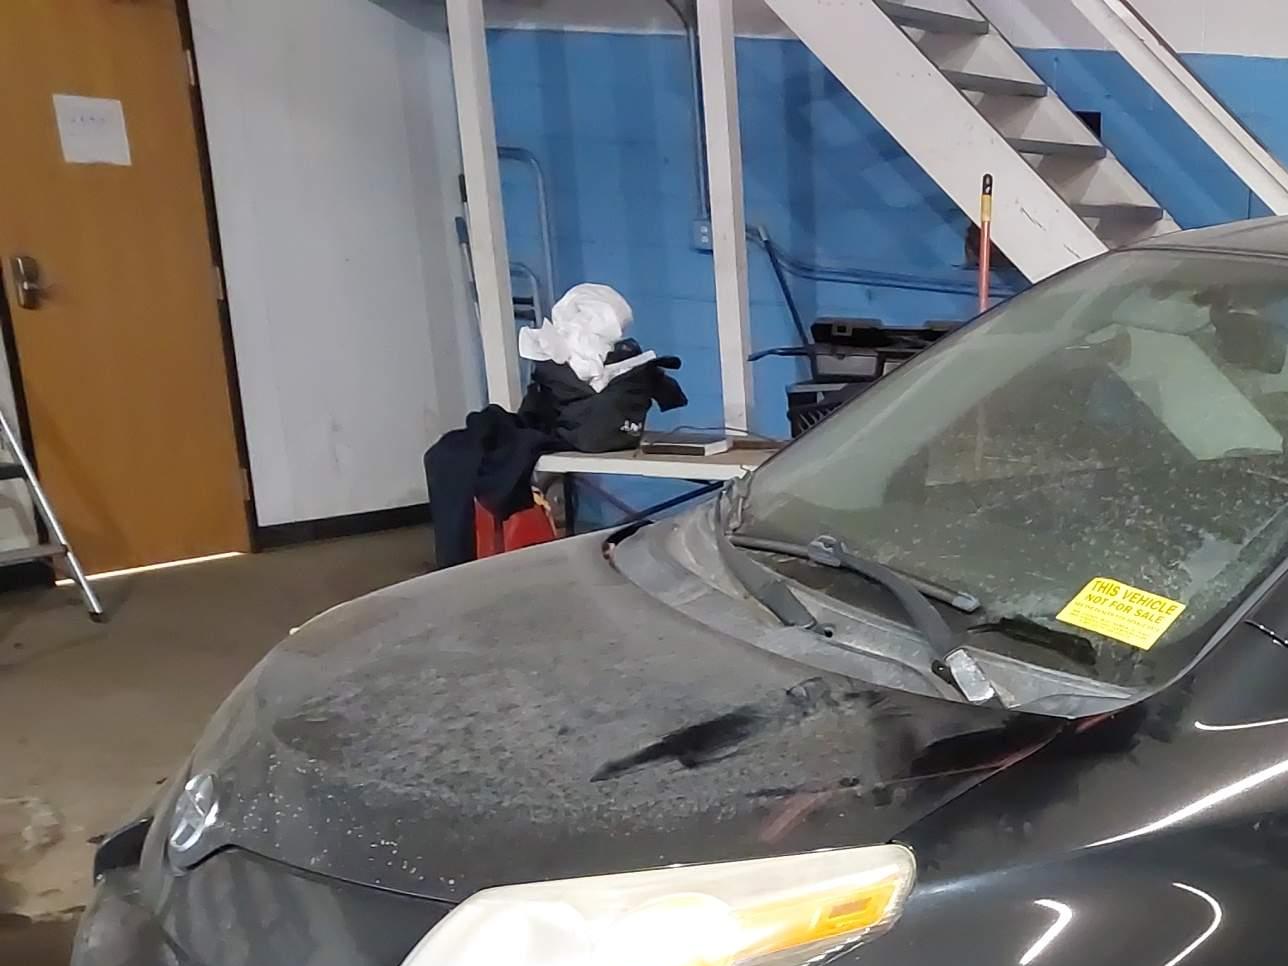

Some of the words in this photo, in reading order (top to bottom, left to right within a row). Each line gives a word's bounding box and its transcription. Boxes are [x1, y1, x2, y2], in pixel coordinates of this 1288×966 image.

[1085, 593, 1109, 606] NOT
[1109, 600, 1133, 614] FOR
[1134, 609, 1165, 624] SALE
[1091, 580, 1120, 597] THIS
[1121, 589, 1178, 615] VEHICLE
